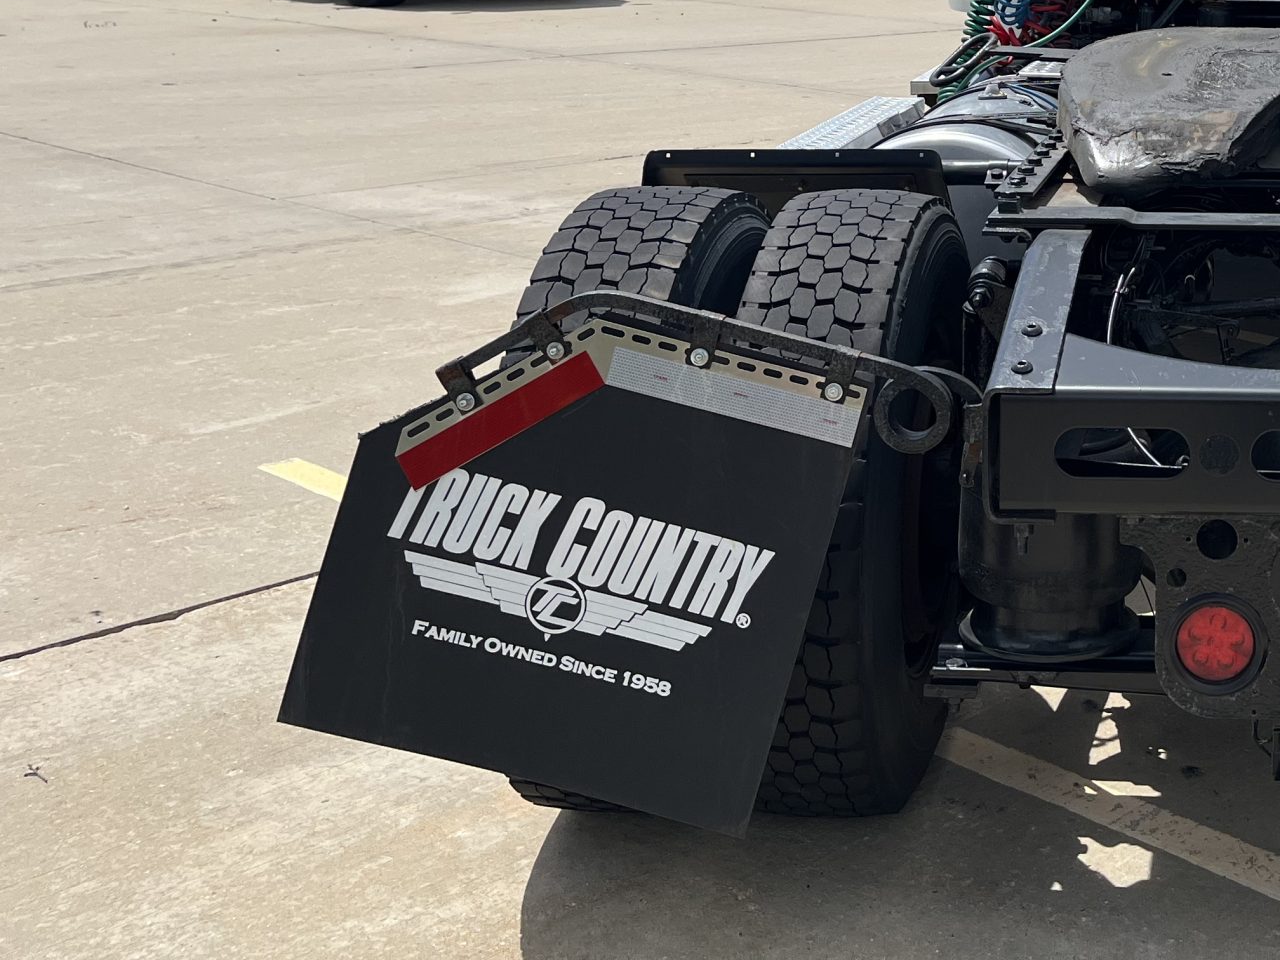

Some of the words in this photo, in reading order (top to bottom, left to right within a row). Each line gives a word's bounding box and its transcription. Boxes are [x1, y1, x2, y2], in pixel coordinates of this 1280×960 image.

[412, 619, 484, 649] FAMILY
[485, 638, 558, 667] OWNED
[559, 656, 618, 683] SINCE
[622, 671, 672, 697] 1958
